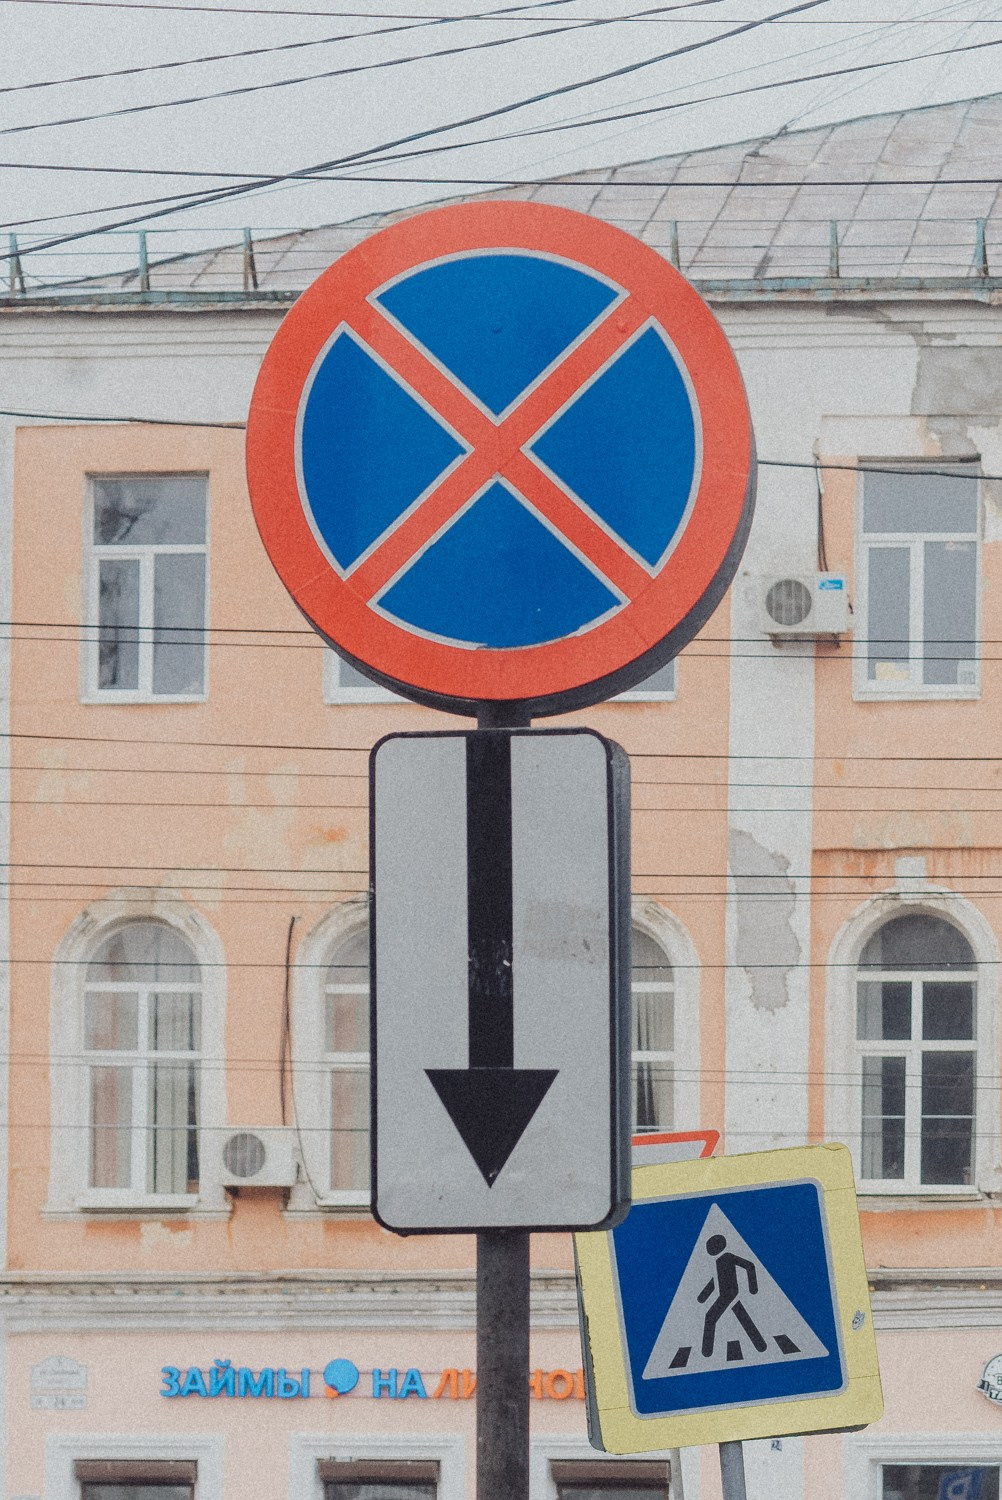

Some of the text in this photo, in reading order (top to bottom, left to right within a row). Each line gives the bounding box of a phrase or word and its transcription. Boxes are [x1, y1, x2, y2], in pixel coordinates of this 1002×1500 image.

[160, 1359, 587, 1400] ЗАЙМЫ НА ЛИНО
